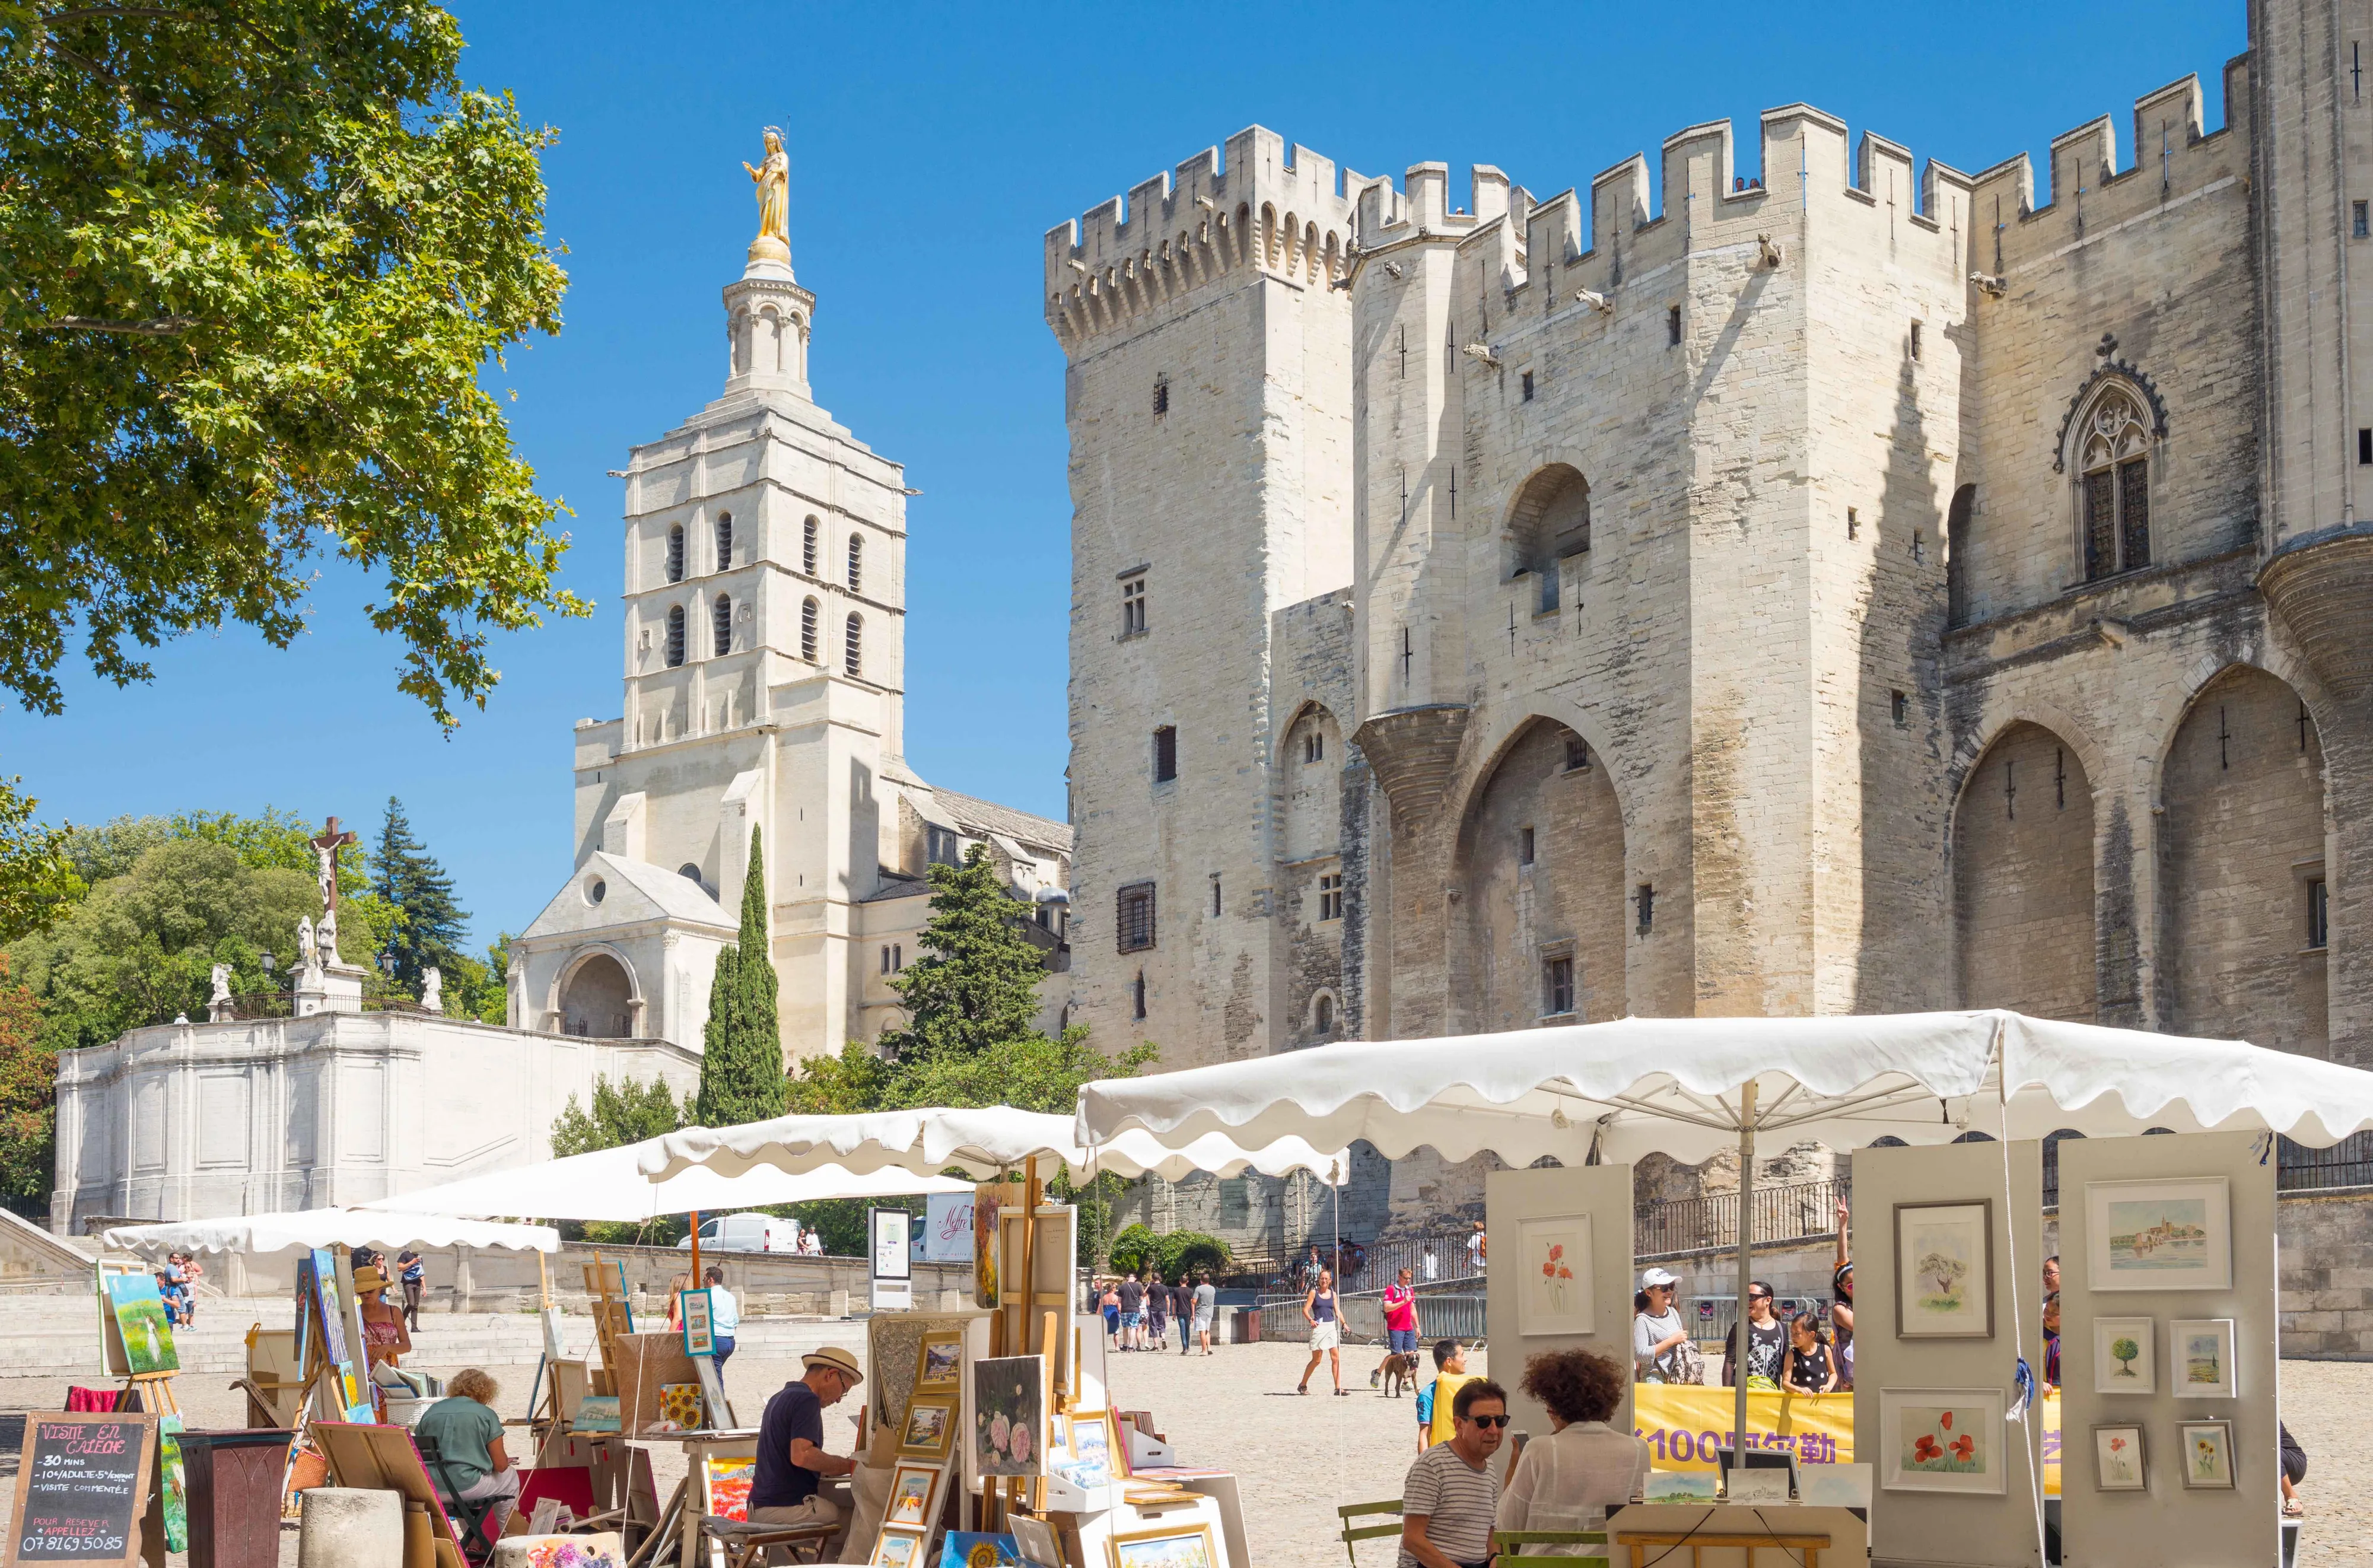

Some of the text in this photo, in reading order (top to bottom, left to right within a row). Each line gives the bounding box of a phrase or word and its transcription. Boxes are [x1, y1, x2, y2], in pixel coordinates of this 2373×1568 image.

[42, 1424, 86, 1440] VISITE
[66, 1439, 126, 1454] CALECHE
[40, 1483, 70, 1491] VISITE
[33, 1518, 110, 1528] POUR RESEVER
[44, 1526, 96, 1537] APPELLEZ
